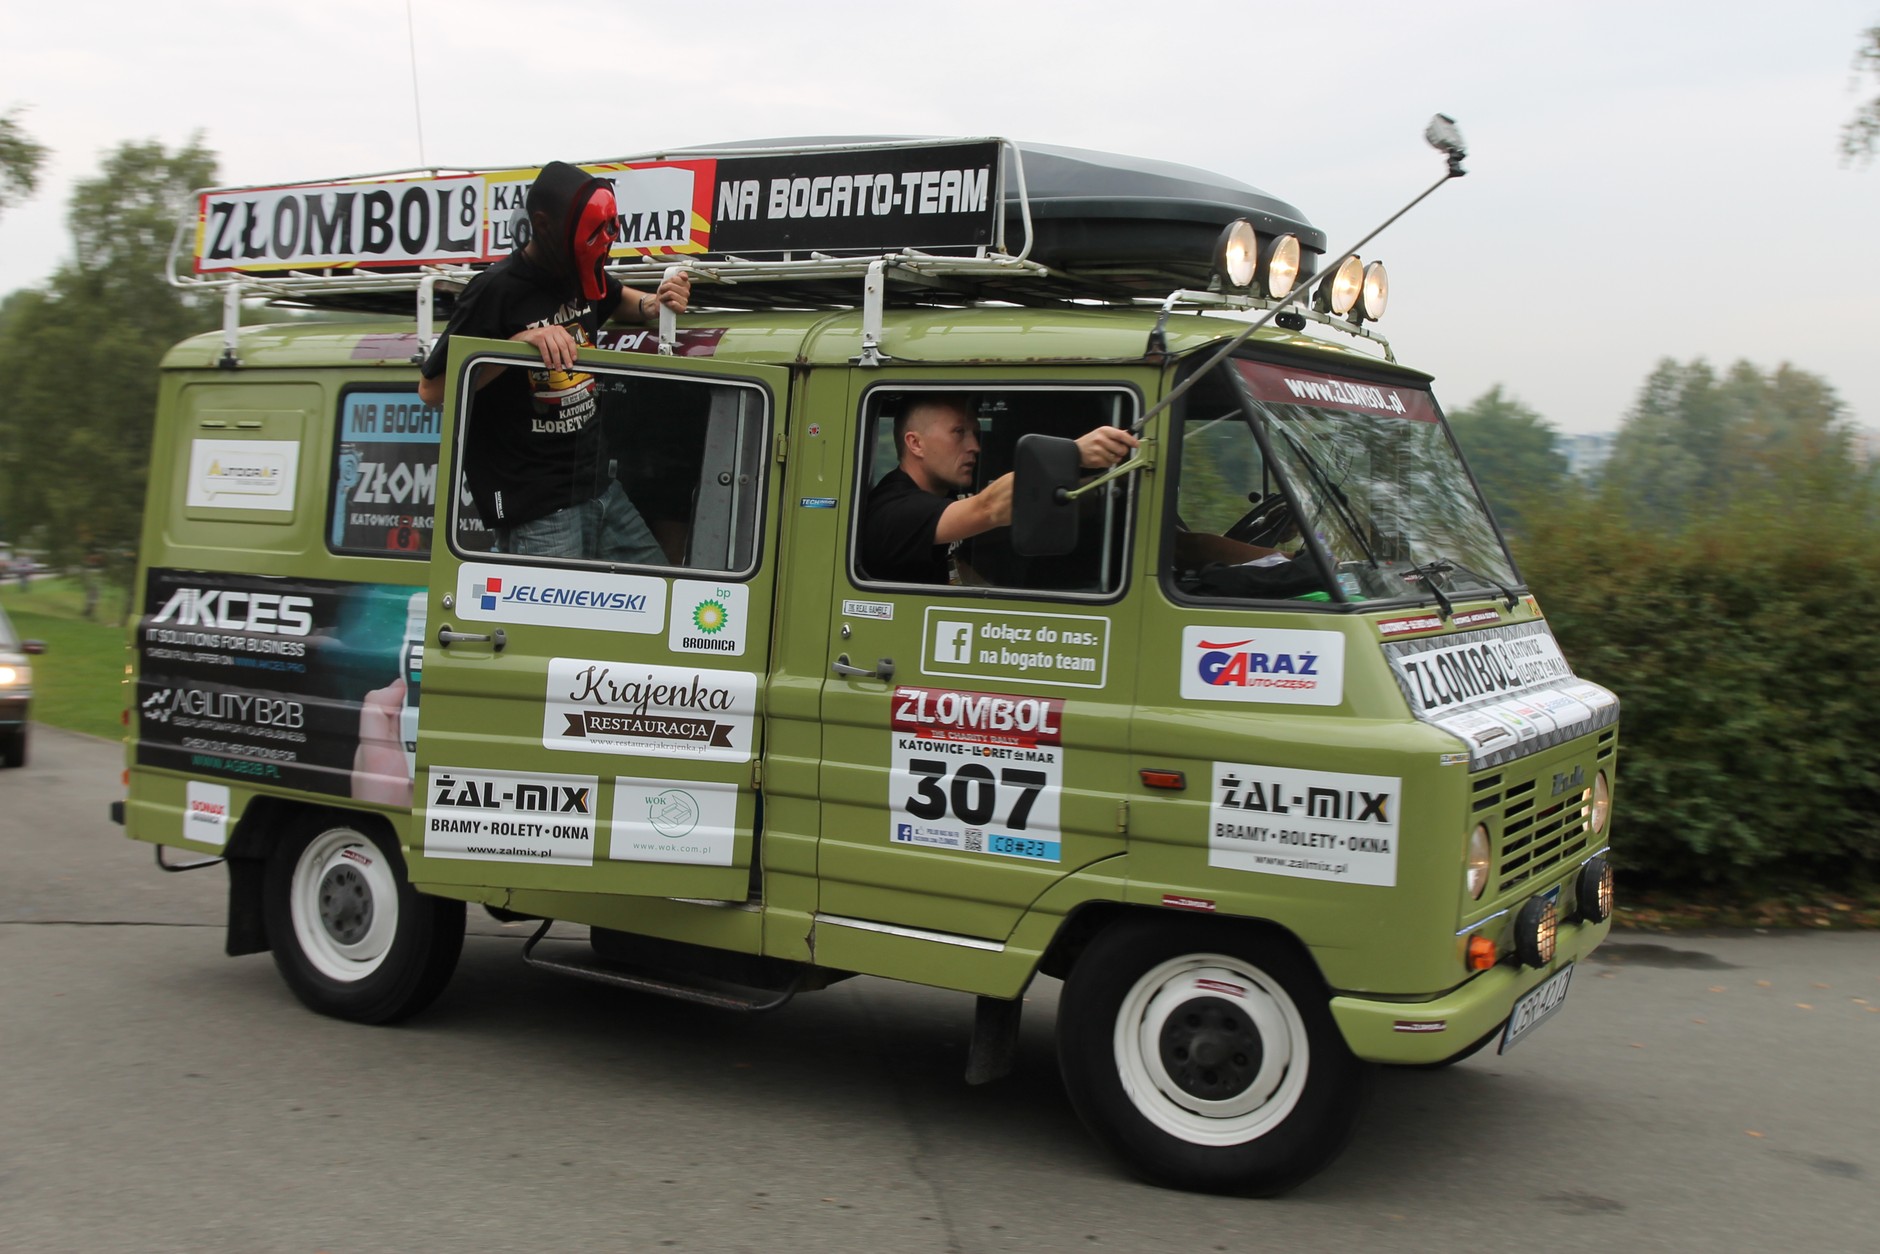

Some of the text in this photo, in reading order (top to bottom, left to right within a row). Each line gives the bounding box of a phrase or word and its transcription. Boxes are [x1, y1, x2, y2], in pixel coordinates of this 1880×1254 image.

[717, 168, 990, 221] NA BOGATO-TEAM
[208, 186, 475, 262] ZŁOMBOL
[617, 209, 686, 244] MAR
[352, 404, 378, 433] NA
[559, 398, 594, 419] KATOWICE
[531, 415, 582, 434] LLORET
[350, 513, 399, 527] KATOWICE
[502, 585, 647, 611] JELENIEWSKI
[716, 587, 731, 599] bp
[151, 588, 313, 636] AKCES
[856, 604, 868, 613] REAL
[159, 629, 221, 648] SOLUTIONS
[221, 635, 246, 650] FOR
[247, 638, 305, 657] BUSINESS
[683, 637, 735, 652] BRODNICA
[980, 623, 1098, 646] dołącz do nas:
[980, 648, 1096, 672] na bogato team
[1199, 650, 1319, 686] GARAŻ
[570, 665, 735, 716] Krajenka
[171, 689, 304, 729] AGILITY B2B
[590, 716, 709, 738] RESTAURACJA
[589, 737, 707, 754] www.restauracjakrajenka.pl
[1026, 752, 1054, 763] MAR
[434, 774, 591, 814] ŻAL-MIX
[645, 796, 666, 806] WOK
[905, 758, 1047, 831] 307
[1221, 773, 1391, 823] ŻAL-MIX
[431, 818, 589, 840] BRAMY ROLETY OKNA
[1216, 823, 1390, 853] BRAMY ROLETY OKNA
[467, 845, 552, 858] www.zalmix.pl
[633, 842, 711, 854] www.wok.com.pl
[1254, 855, 1348, 874] www.zalmix.pl
